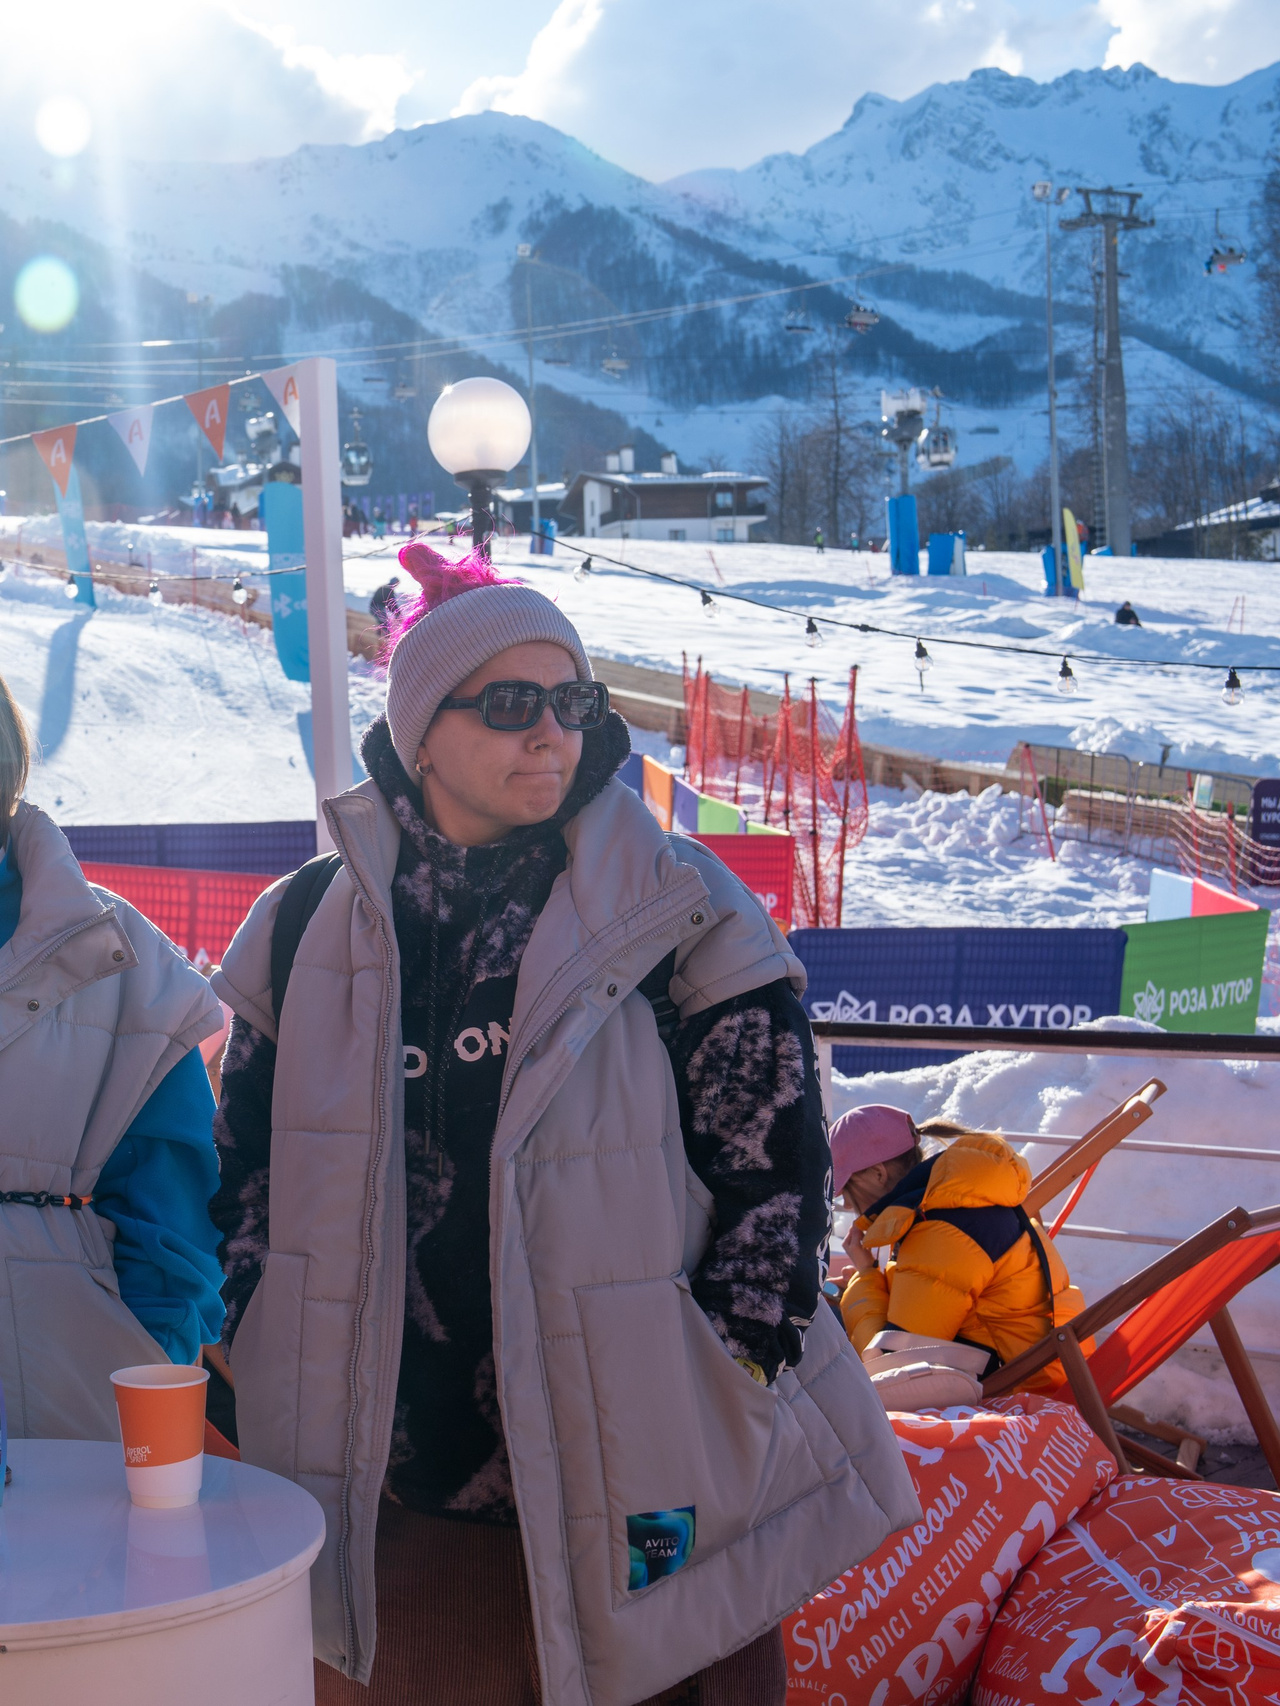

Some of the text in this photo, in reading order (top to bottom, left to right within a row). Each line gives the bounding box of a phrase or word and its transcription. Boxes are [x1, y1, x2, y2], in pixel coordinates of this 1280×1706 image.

[205, 399, 220, 428] A
[129, 419, 144, 444] A
[51, 438, 66, 467] A
[1170, 977, 1253, 1017] РОЗА ХУТОР
[889, 1004, 1092, 1029] РОЗА ХУТОР
[645, 1537, 680, 1549] AVITO
[646, 1548, 677, 1559] TEAM
[792, 1473, 968, 1672] Spontaneous
[846, 1608, 912, 1680] RADICI
[911, 1500, 1003, 1615] SELEZIONATE
[987, 1645, 1031, 1682] Italia
[787, 1678, 829, 1694] GINALE
